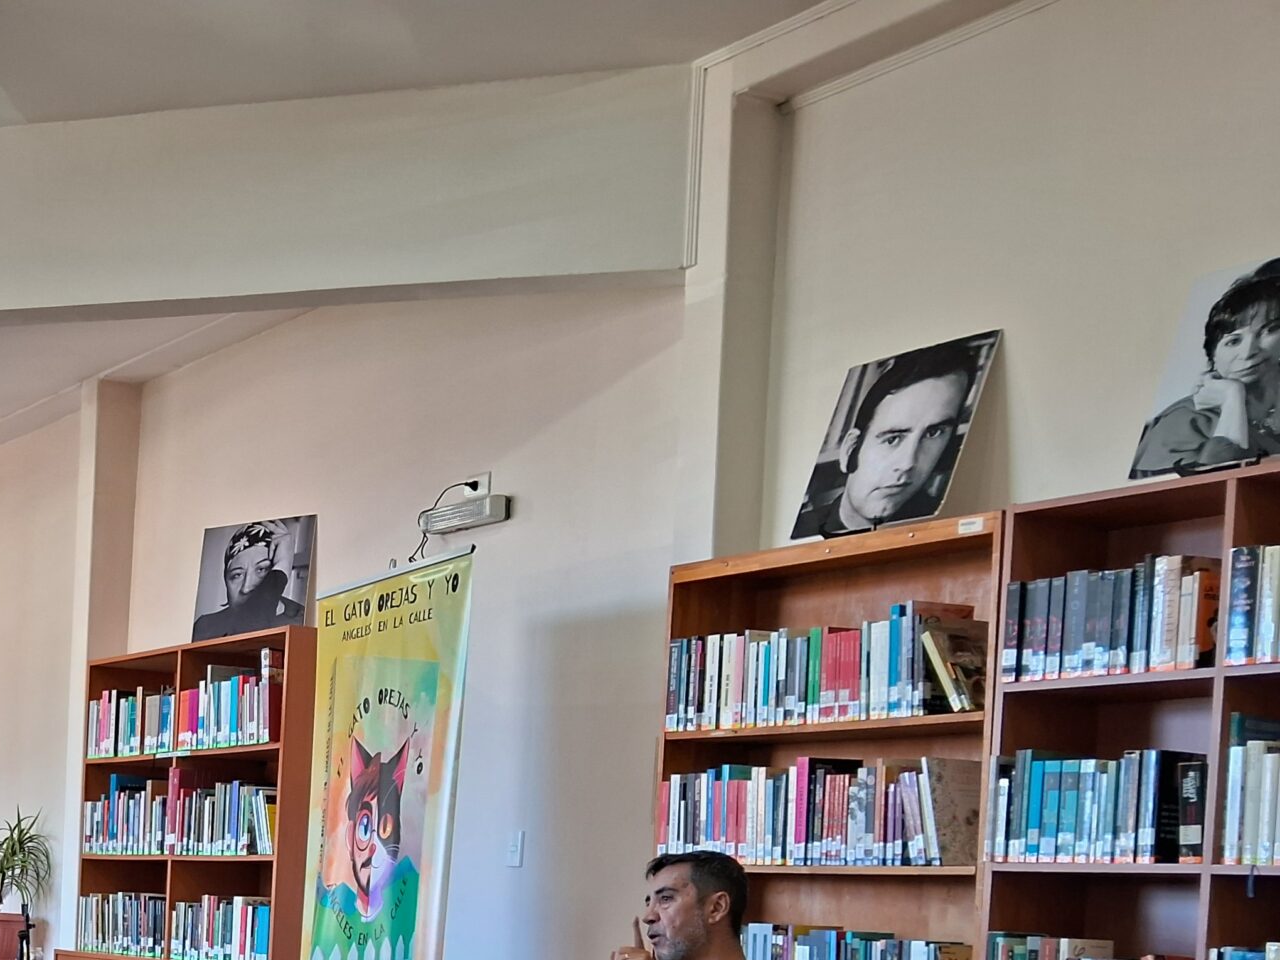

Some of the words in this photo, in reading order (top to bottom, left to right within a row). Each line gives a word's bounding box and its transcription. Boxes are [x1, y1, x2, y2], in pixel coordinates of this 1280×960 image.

[325, 609, 336, 627] EL
[344, 598, 371, 622] GATO
[377, 584, 418, 613] OREJAS
[427, 579, 435, 600] Y
[445, 572, 459, 596] YO
[341, 622, 372, 642] ANGELES
[378, 619, 388, 632] EN
[393, 616, 404, 629] LA
[408, 608, 433, 624] CALLE
[348, 697, 370, 738] GATO
[377, 687, 411, 720] OREJAS
[410, 722, 418, 738] Y
[357, 931, 368, 946] EN
